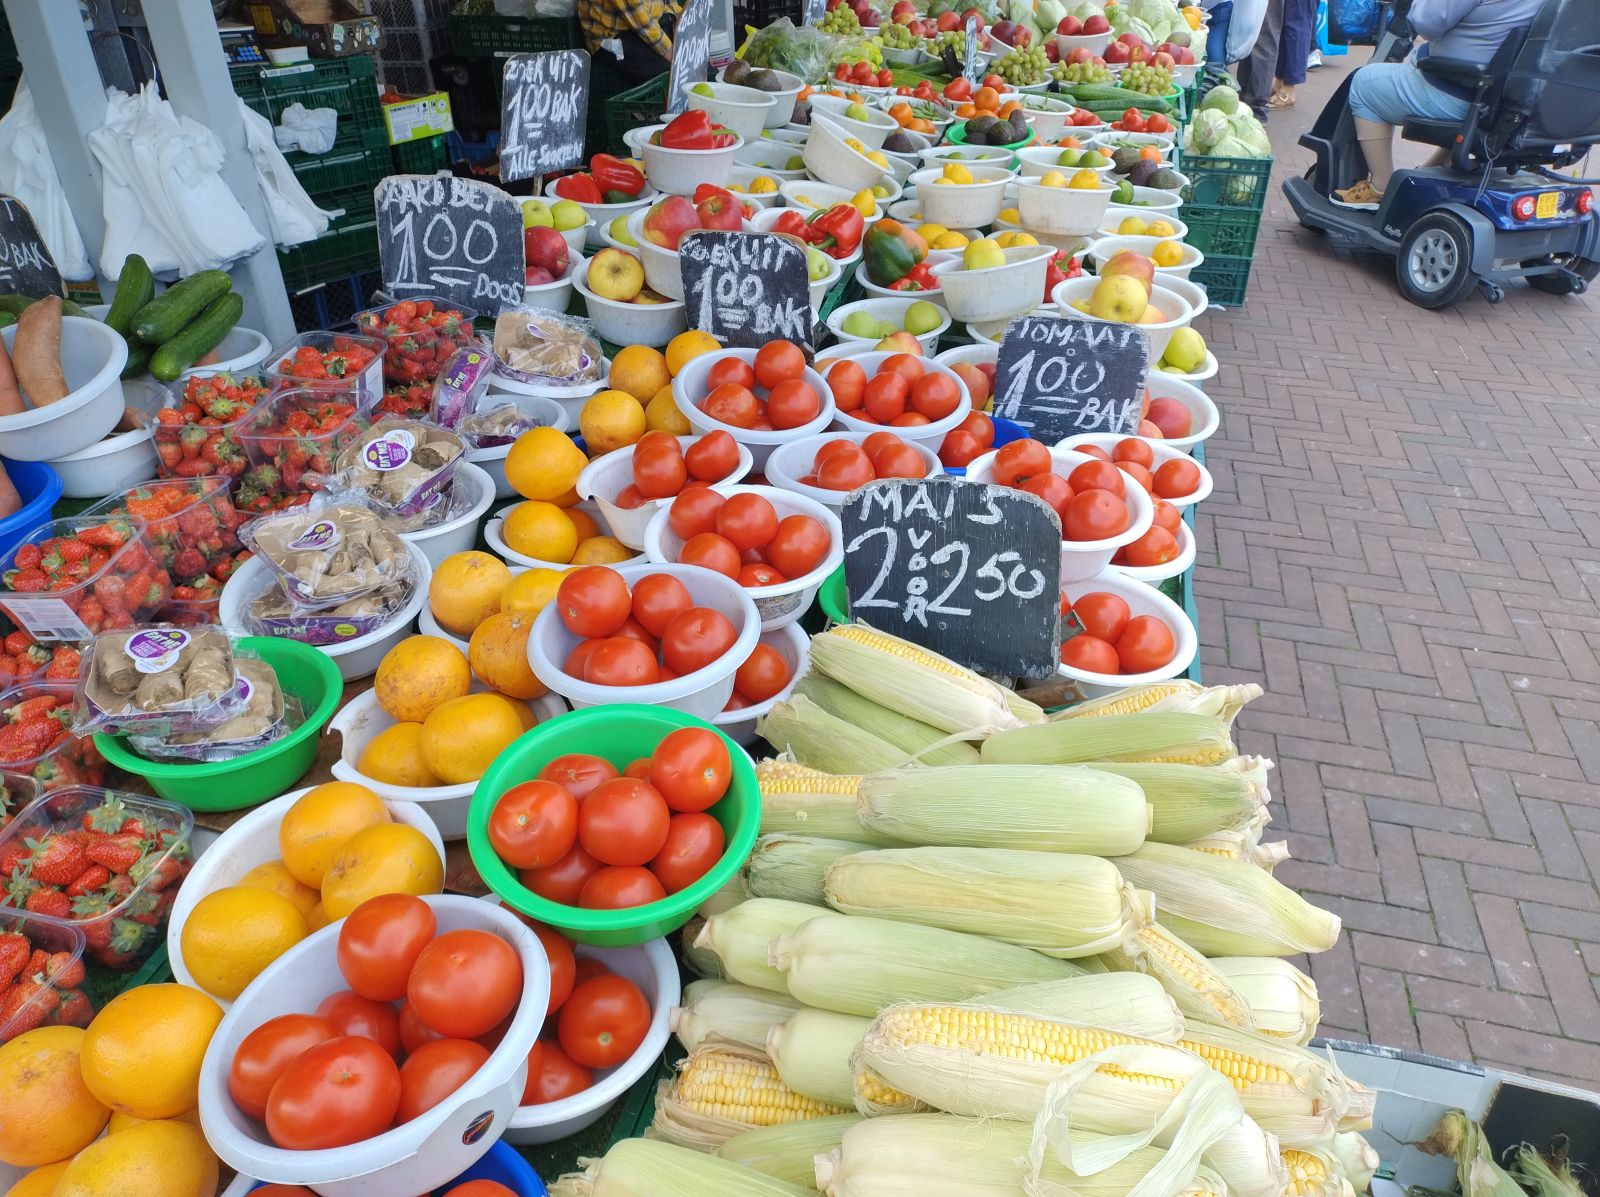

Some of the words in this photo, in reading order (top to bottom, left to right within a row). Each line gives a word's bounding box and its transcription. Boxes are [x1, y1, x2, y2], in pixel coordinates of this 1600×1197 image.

[549, 51, 583, 83] UIT
[501, 83, 551, 155] 100
[550, 82, 583, 123] BAK
[507, 143, 538, 180] ALLE
[10, 241, 53, 271] BAK
[385, 211, 499, 290] 100
[740, 235, 801, 273] UIT
[472, 272, 524, 306] DOOS
[691, 265, 764, 342] 100
[750, 297, 809, 340] BAK
[1016, 318, 1136, 349] TOMAAT
[996, 349, 1106, 428] 100
[1073, 396, 1141, 435] BAK
[421, 489, 433, 501] EAT
[859, 483, 1004, 525] MAIS
[846, 526, 899, 608] 2
[902, 527, 933, 629] VOOR
[274, 626, 291, 635] EAT
[292, 625, 307, 635] ME
